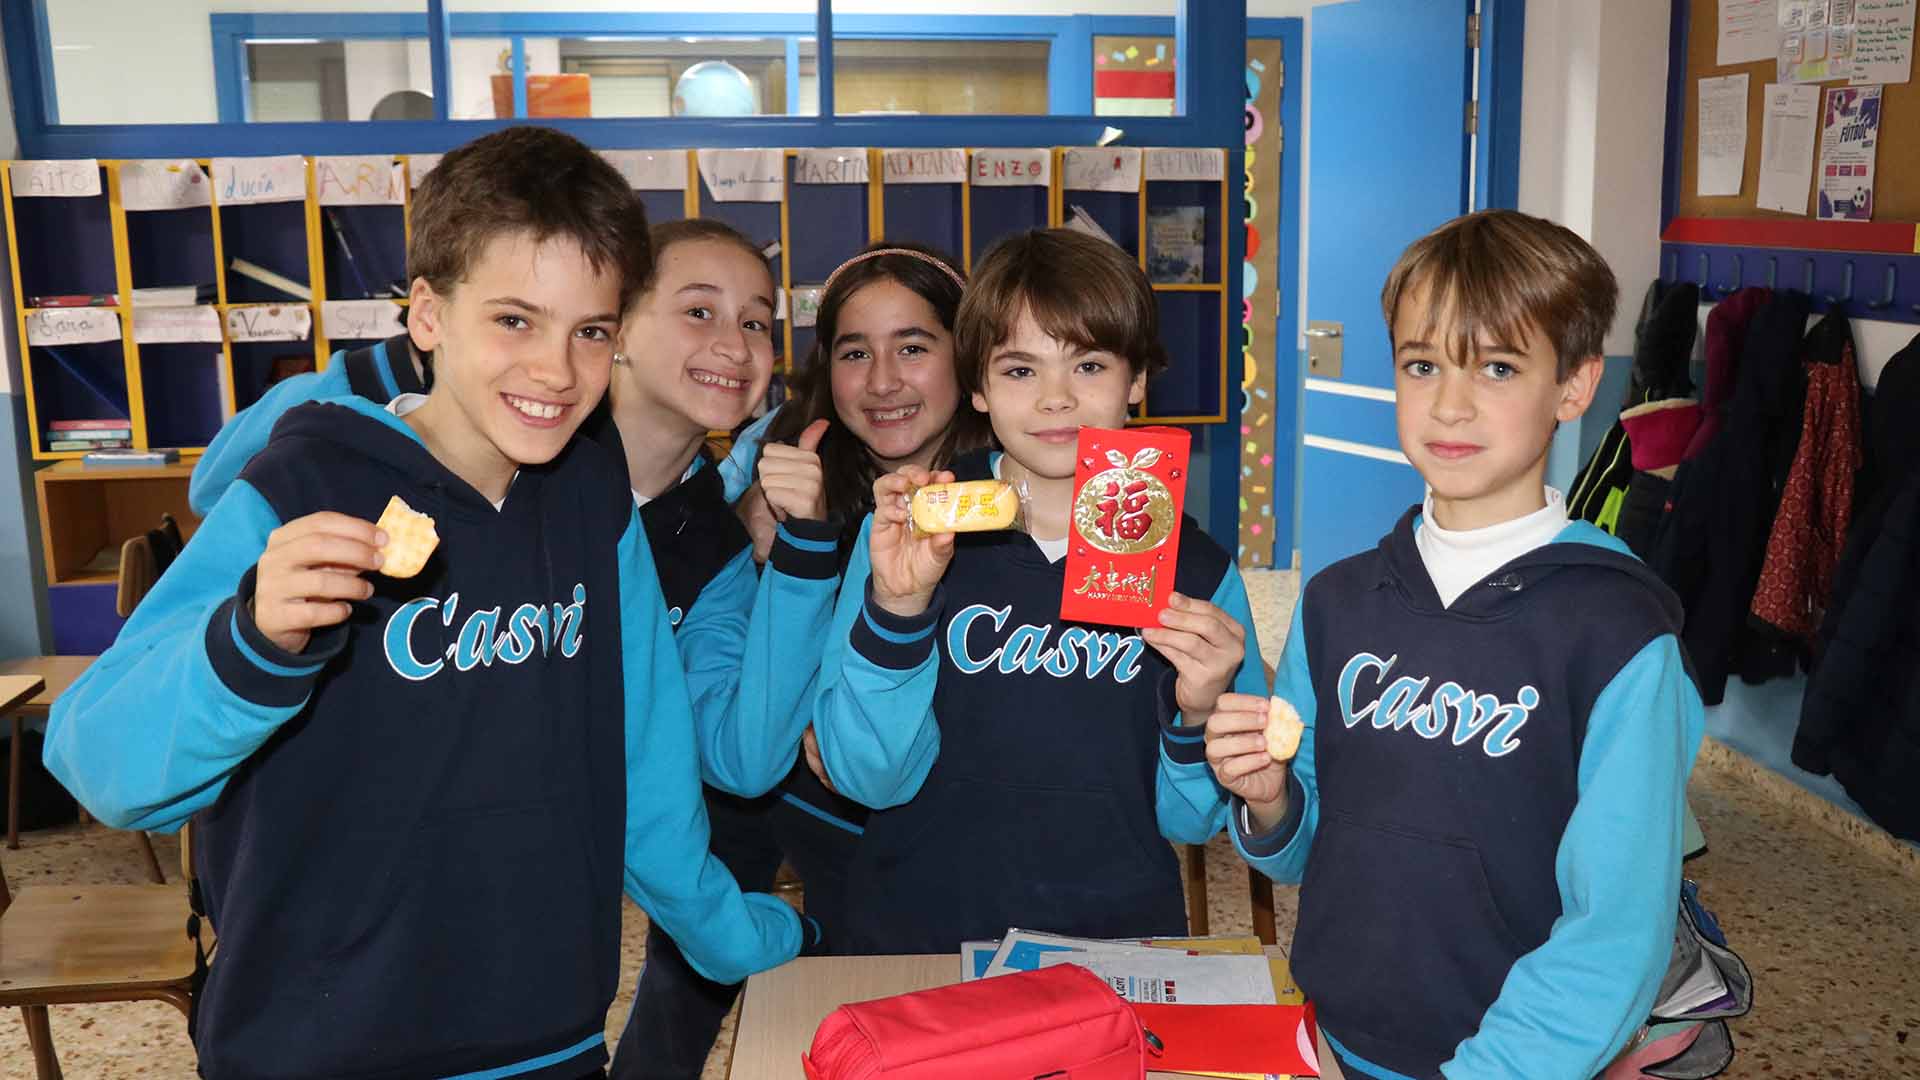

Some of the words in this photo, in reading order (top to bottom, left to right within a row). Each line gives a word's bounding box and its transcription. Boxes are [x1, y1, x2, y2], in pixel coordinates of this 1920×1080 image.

[978, 158, 1042, 177] ENZO
[1094, 481, 1152, 541] 福
[947, 604, 1144, 683] Casvi
[1338, 652, 1540, 757] Casvi
